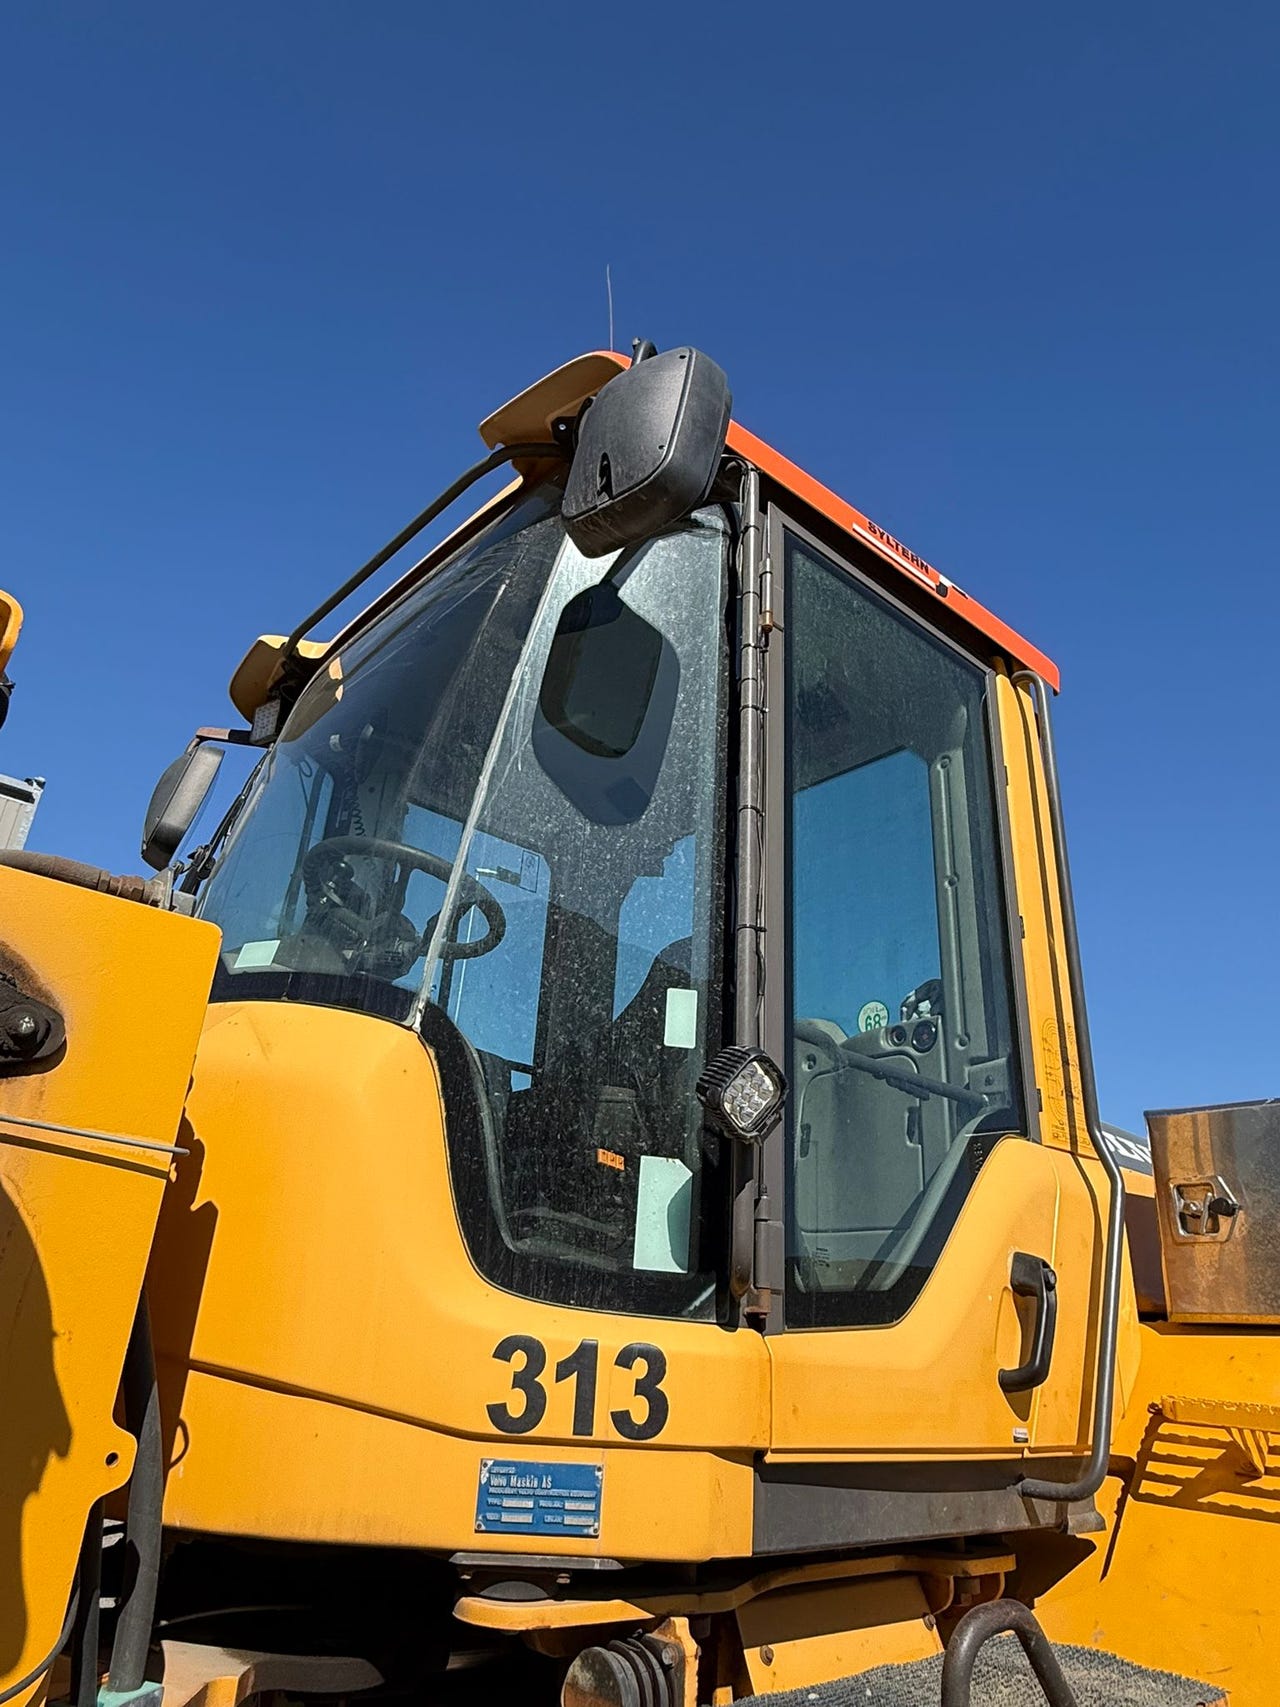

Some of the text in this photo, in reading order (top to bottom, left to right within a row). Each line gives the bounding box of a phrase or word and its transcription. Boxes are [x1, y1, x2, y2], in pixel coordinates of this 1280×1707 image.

[867, 521, 930, 575] SYLTERN
[865, 1013, 882, 1031] 68
[486, 1334, 669, 1440] 313
[490, 1474, 552, 1489] Volvo Maskin AS
